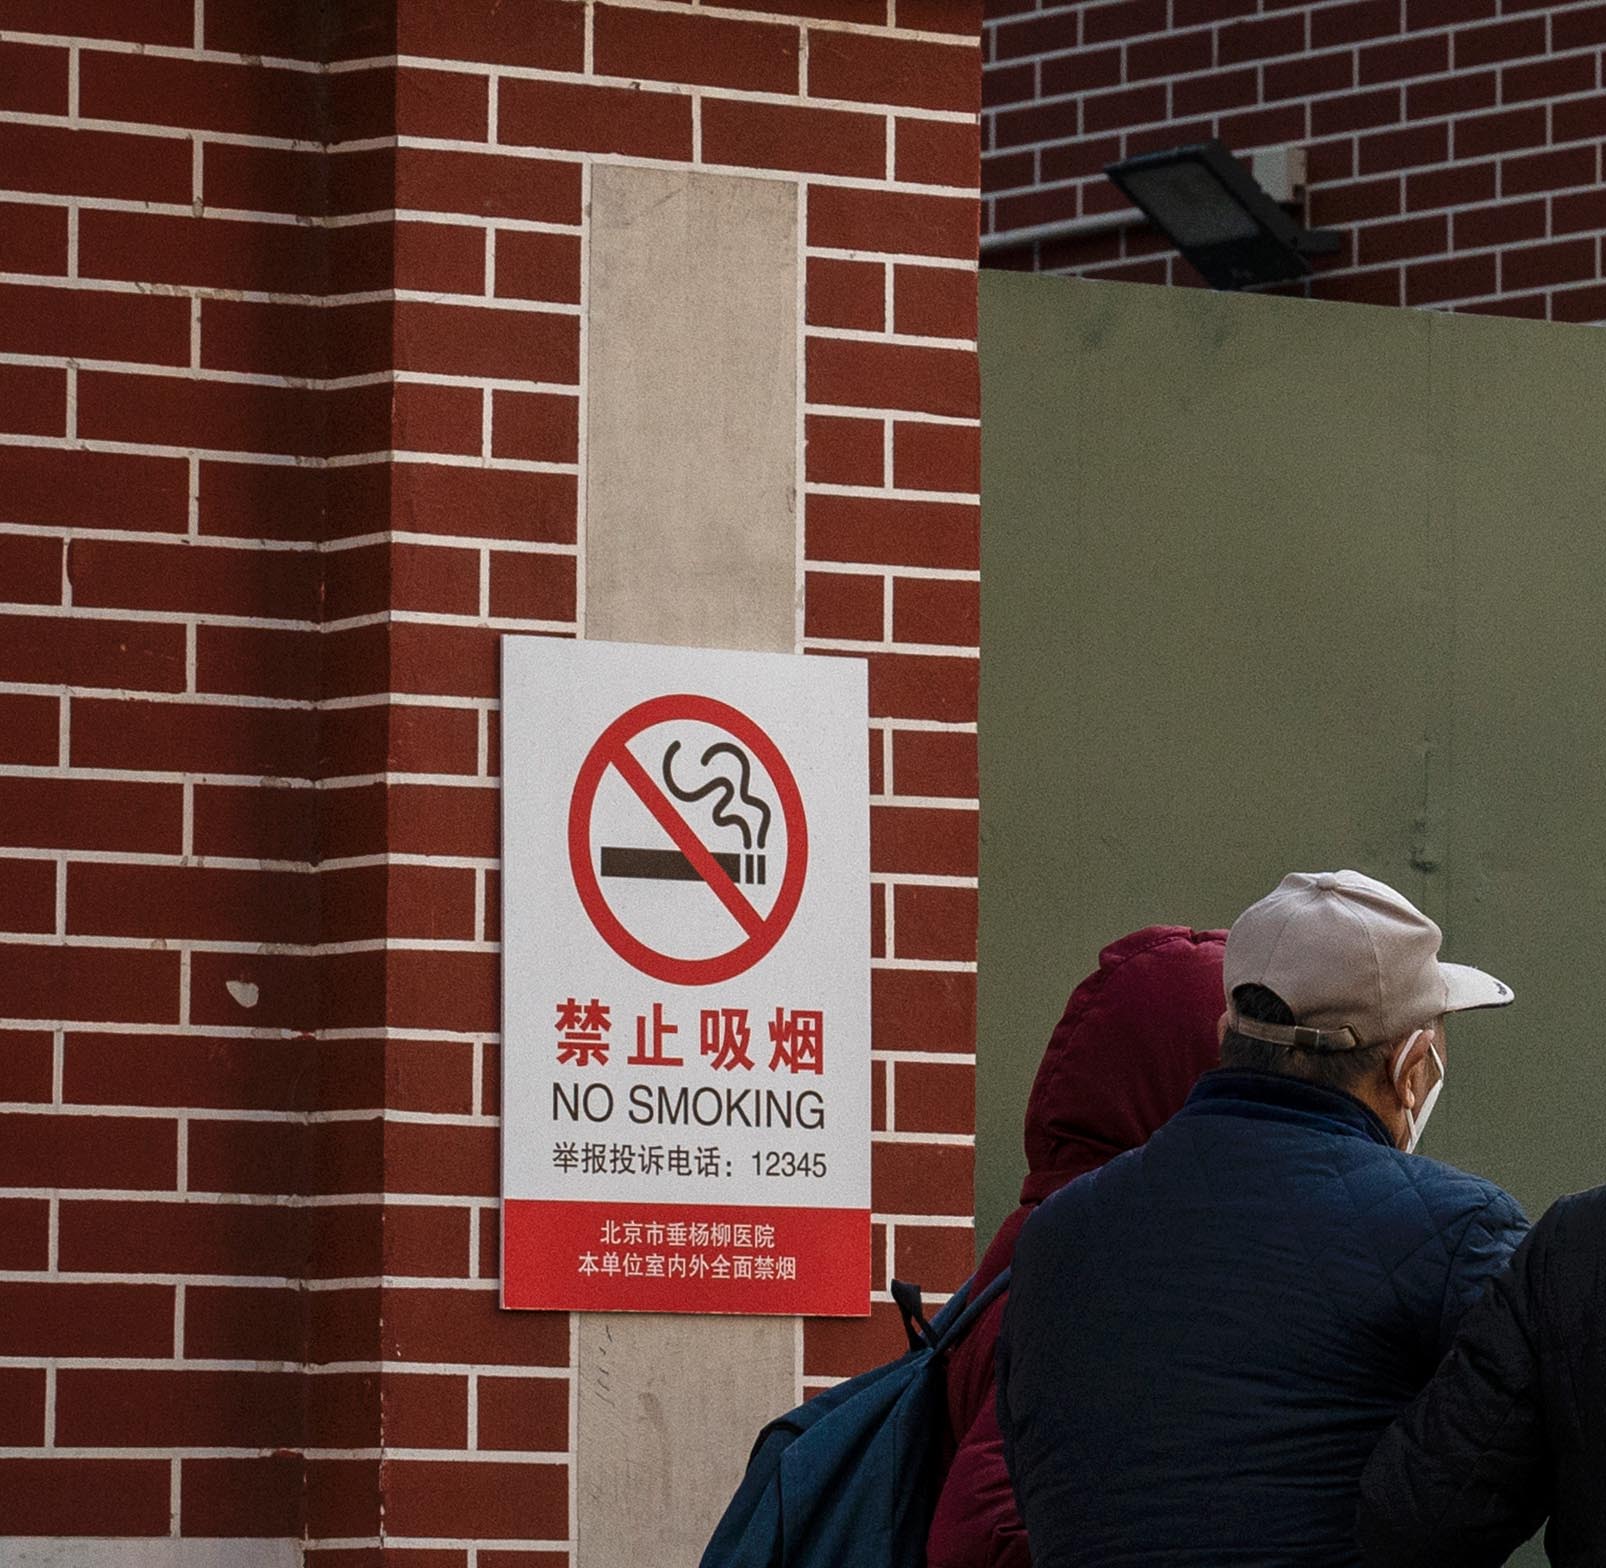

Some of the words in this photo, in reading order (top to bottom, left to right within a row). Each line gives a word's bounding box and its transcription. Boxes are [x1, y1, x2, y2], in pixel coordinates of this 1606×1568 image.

[554, 998, 825, 1075] 禁止吸烟
[552, 1082, 614, 1123] NO
[628, 1085, 826, 1130] SMOKING
[599, 1219, 776, 1249] 北京市垂杨柳医院
[577, 1252, 797, 1281] 本单位室内外全面禁烟
